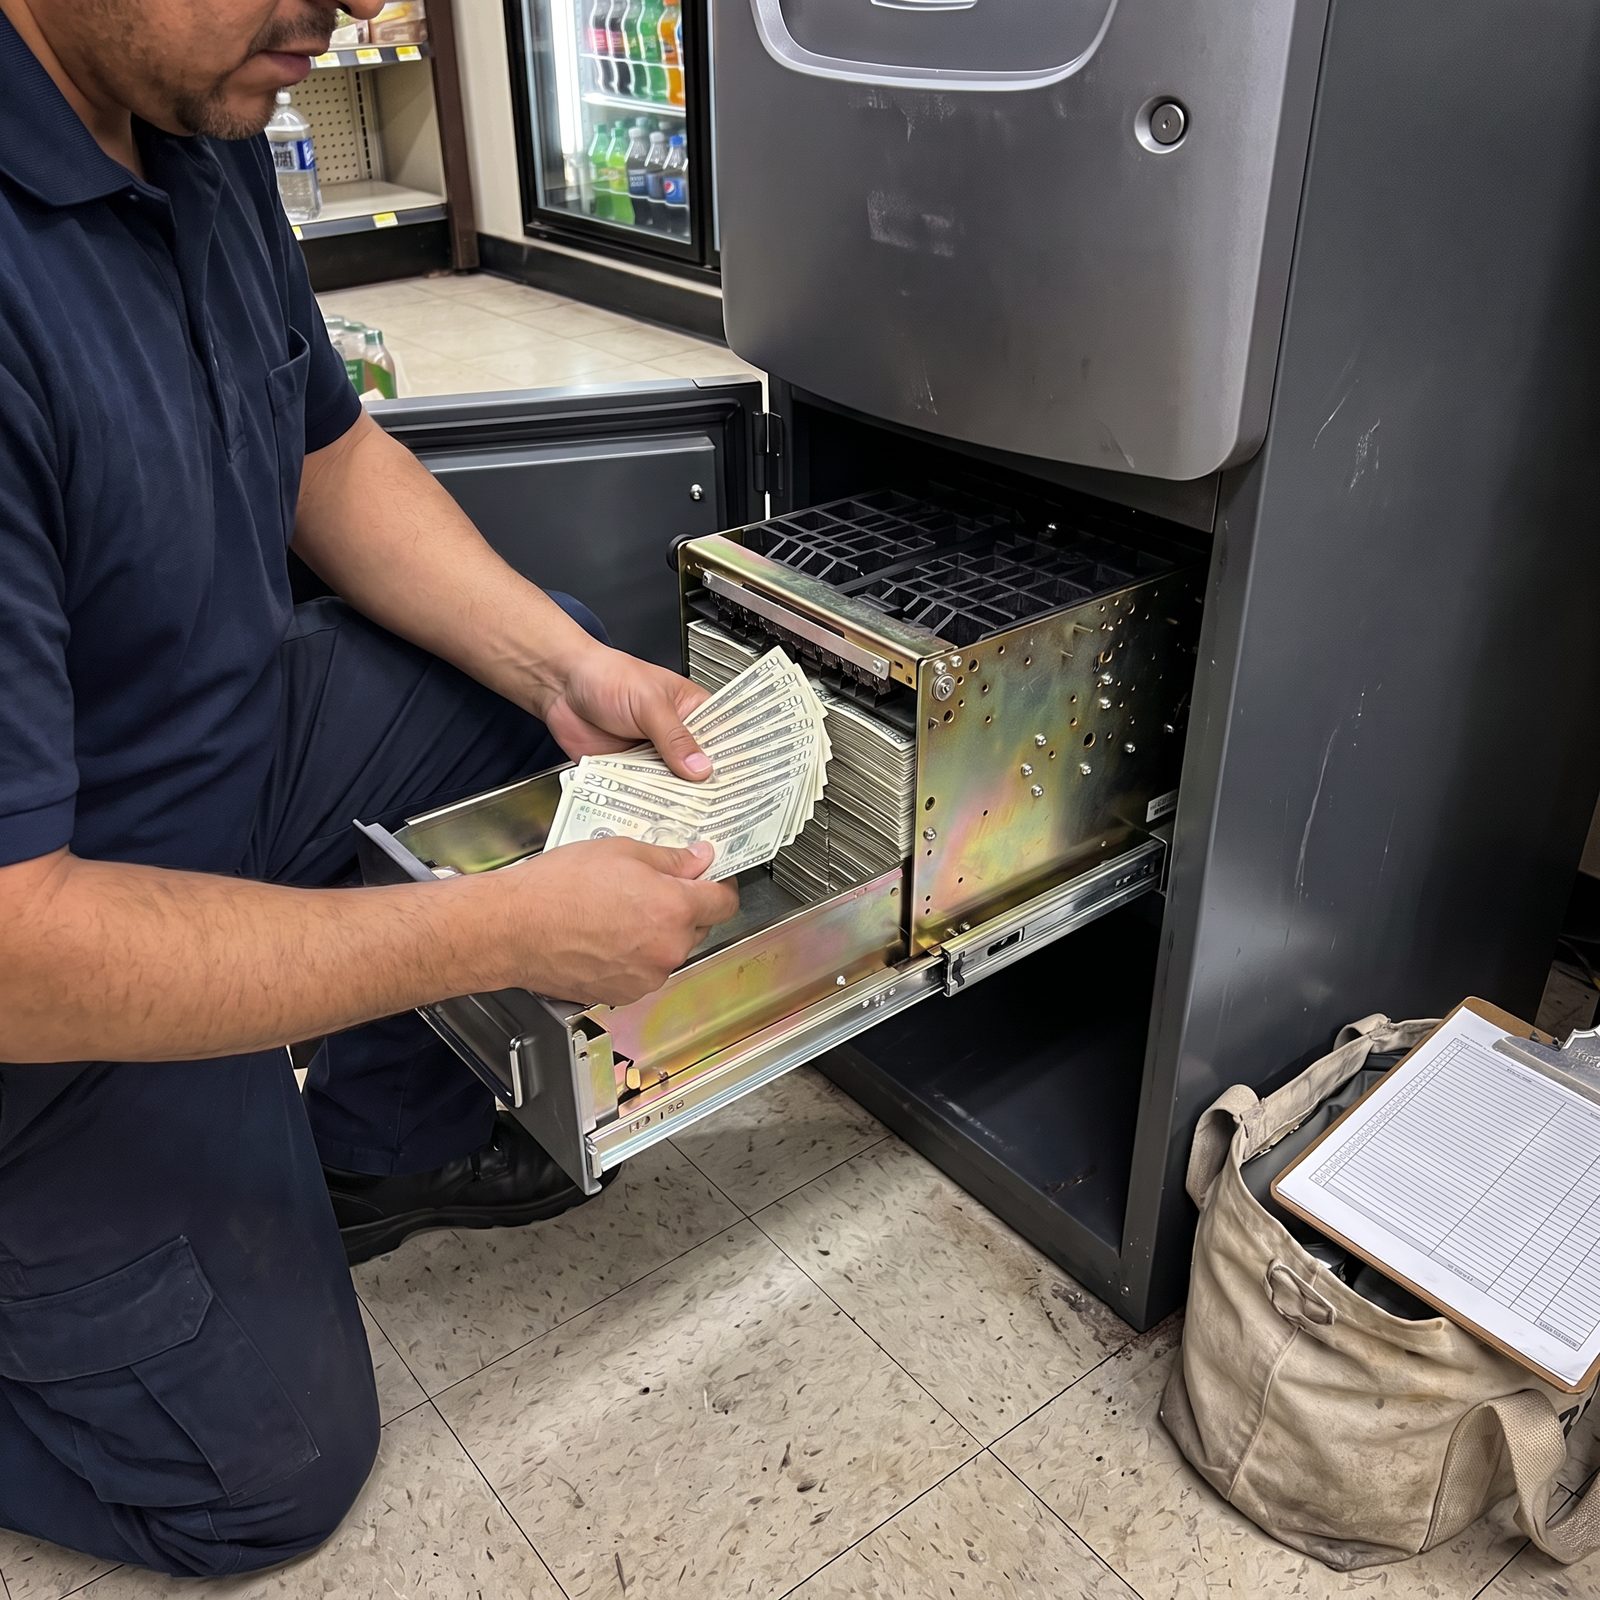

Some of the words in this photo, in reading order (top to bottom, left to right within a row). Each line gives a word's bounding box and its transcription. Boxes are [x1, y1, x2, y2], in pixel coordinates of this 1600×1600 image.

[755, 655, 780, 677] 20
[772, 671, 797, 691] 20
[778, 694, 803, 712] 20
[789, 717, 814, 732] 20
[584, 772, 620, 793] 20
[572, 786, 609, 807] 20
